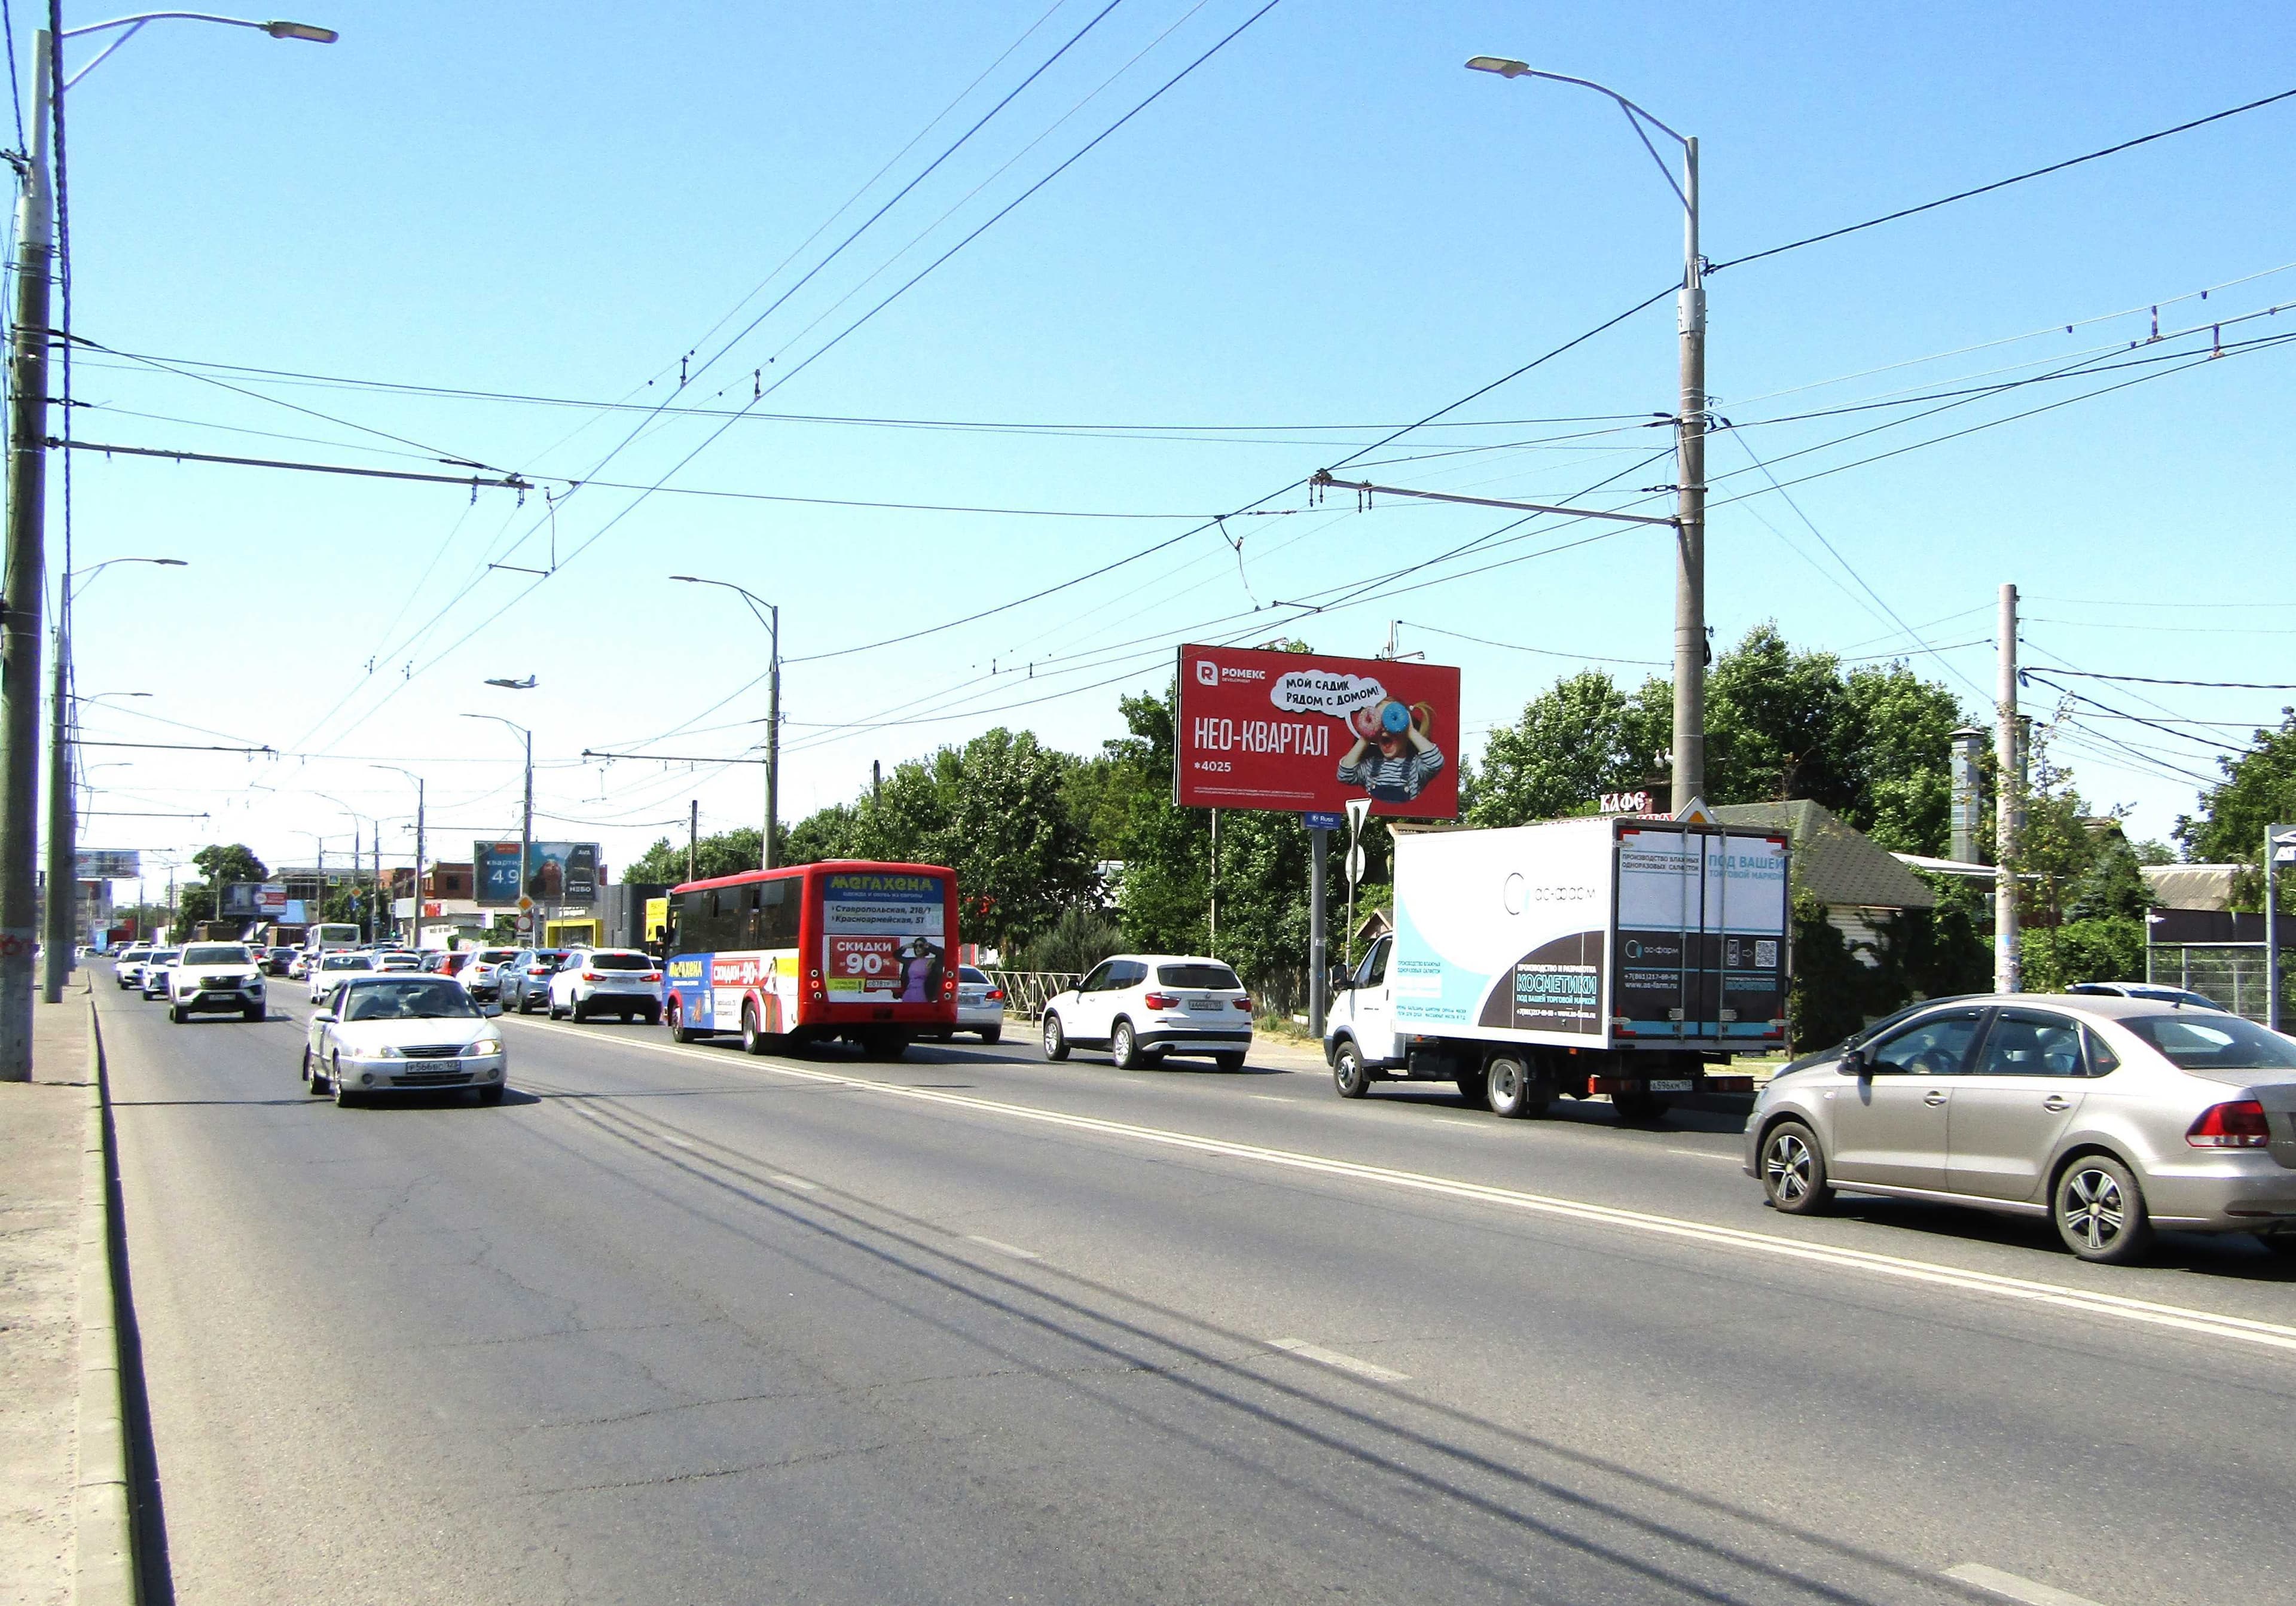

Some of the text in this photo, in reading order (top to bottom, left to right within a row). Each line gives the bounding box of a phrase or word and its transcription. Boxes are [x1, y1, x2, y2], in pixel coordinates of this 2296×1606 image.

[1222, 667, 1266, 680] РОМЕКС
[1286, 678, 1349, 691] МОЙ САДИК
[1286, 686, 1380, 706] РЯДОМ С ДОМОМ!
[1194, 717, 1329, 756] НЕО-КВАРТАЛ
[1599, 792, 1647, 813] КАФЕ
[1622, 862, 1666, 870] ОДНОРАЗОВЫХ
[1709, 854, 1736, 869] ПОД
[1709, 869, 1750, 879] ТОРОВОЙ
[835, 905, 907, 914] Ставропольская,
[835, 915, 913, 924] Красноармейская,
[837, 942, 892, 952] СКИДКИ
[713, 965, 740, 984] СКИДКИ
[1516, 973, 1597, 995] КОСМЕТИКИ
[1516, 994, 1596, 1005] ПОД ВАШЕЙ ТОРГОВОЙ МАРКОЙ
